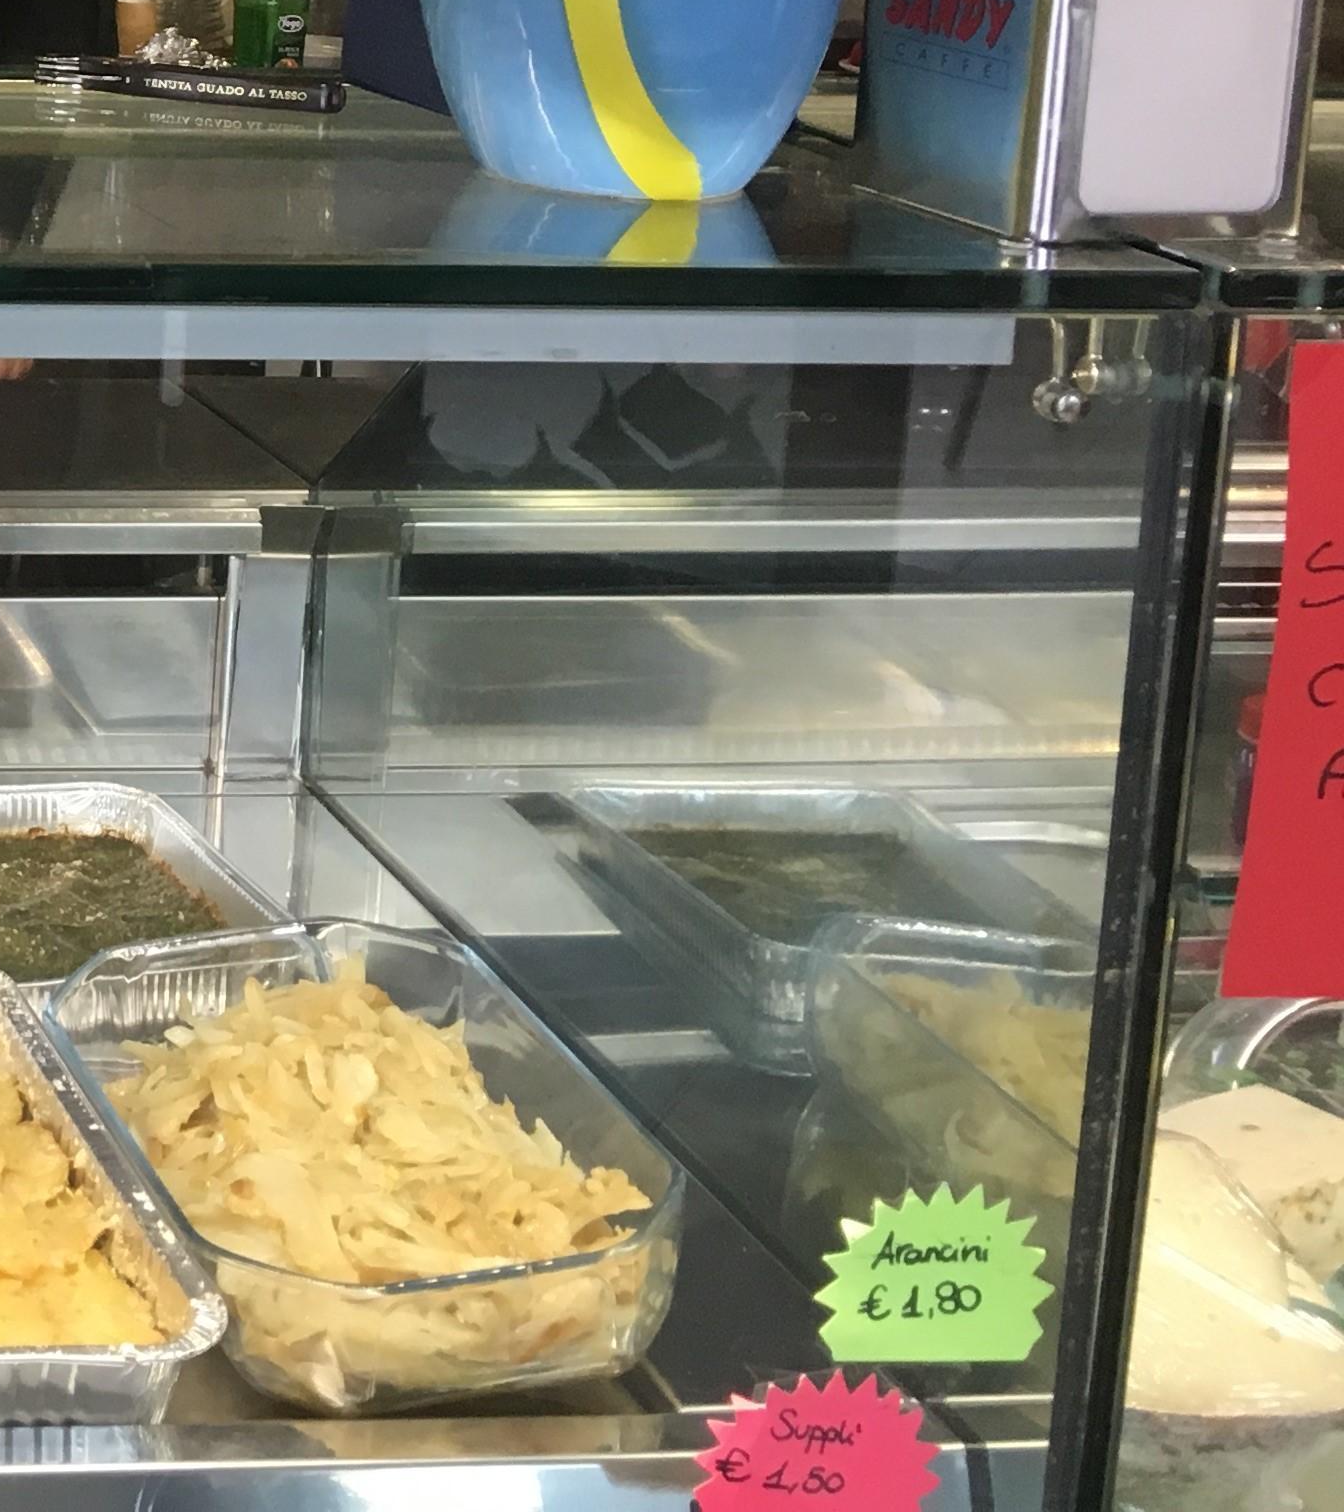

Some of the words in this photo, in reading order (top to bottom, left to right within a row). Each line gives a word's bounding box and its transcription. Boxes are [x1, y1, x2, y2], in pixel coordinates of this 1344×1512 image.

[143, 78, 192, 92] TENUTA
[196, 82, 245, 96] GUADO
[248, 87, 265, 98] AL
[269, 89, 308, 102] TASSO
[870, 1230, 991, 1270] Arancini
[899, 1280, 983, 1322] 1,80
[761, 1460, 846, 1495] 1,50
